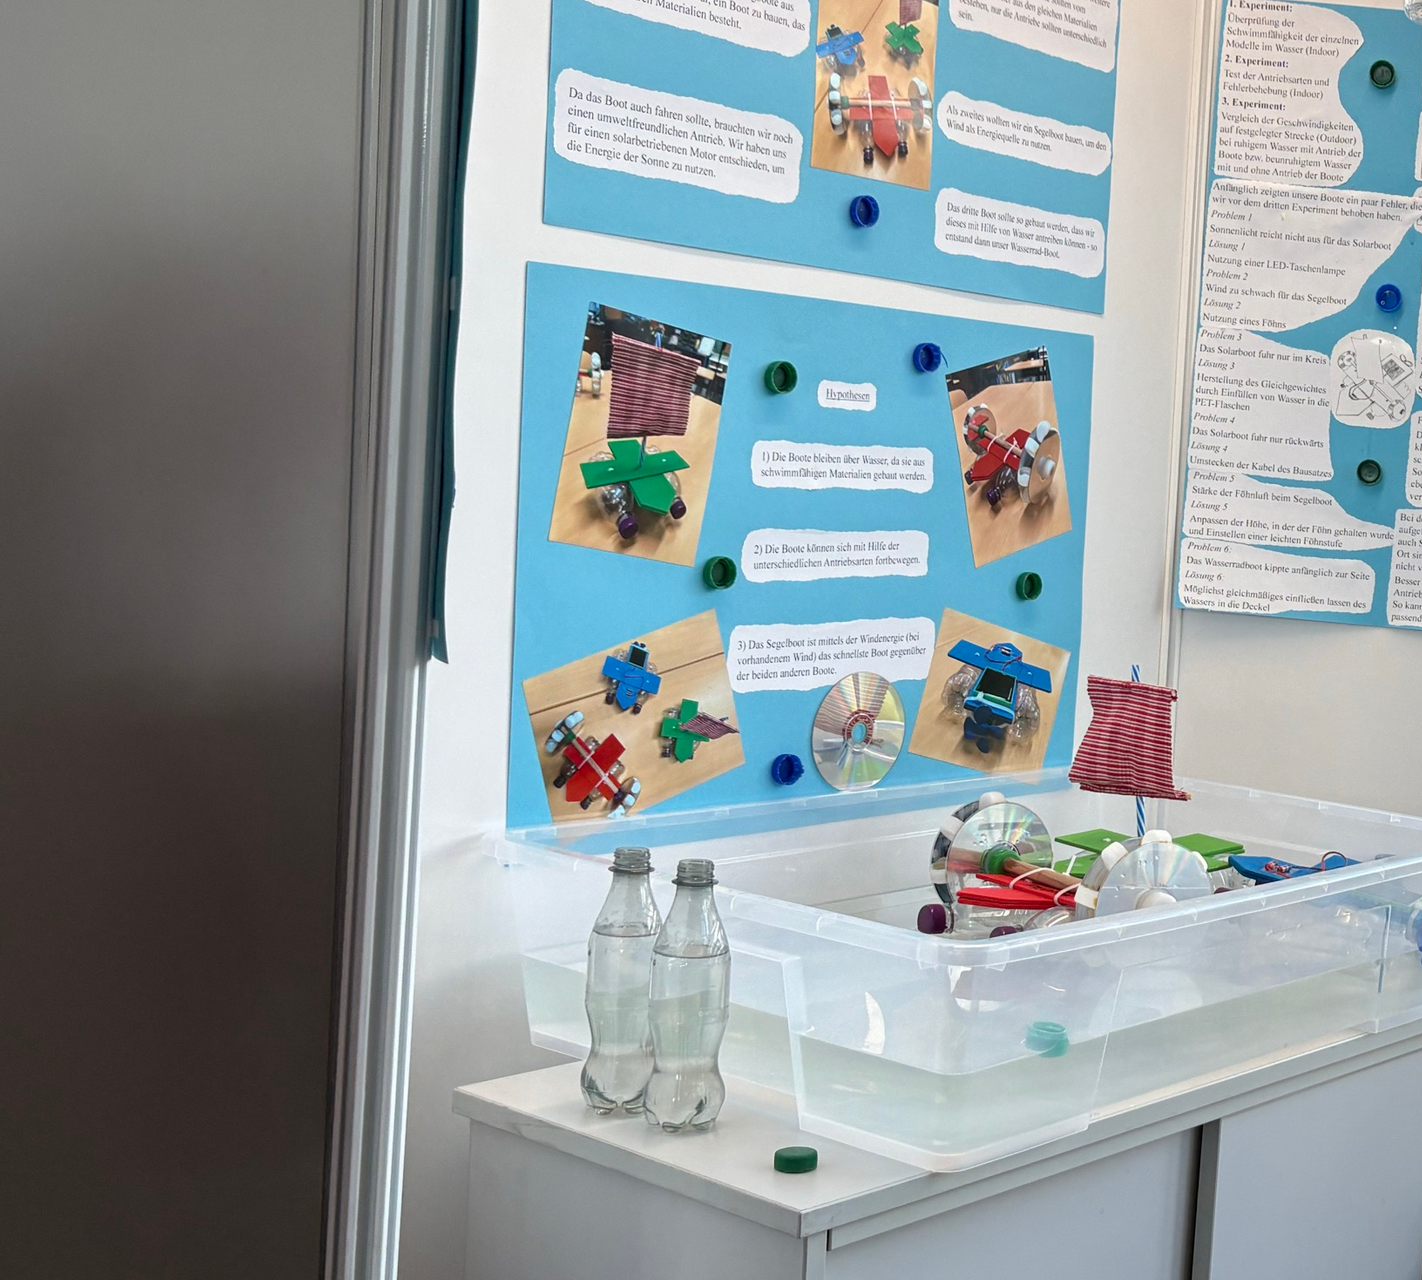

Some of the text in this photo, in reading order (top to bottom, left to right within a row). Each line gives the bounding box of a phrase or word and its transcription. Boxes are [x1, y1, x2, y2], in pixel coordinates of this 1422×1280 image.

[1239, 1, 1292, 12] Experiment:
[709, 11, 742, 29] besteht.
[729, 1, 750, 15] Boot
[752, 8, 762, 18] zu
[764, 10, 790, 28] bauen,
[792, 18, 806, 32] das
[1228, 12, 1295, 28] Überprüfung der
[1227, 27, 1359, 46] Schwimmfähigkeit der einzelnen
[1226, 39, 1340, 58] Modelle im Wasser (Indoor)
[1225, 54, 1289, 68] 2. Experiment:
[1224, 69, 1330, 86] Test der Antriebsarten und
[1223, 82, 1324, 100] Fehlerbehebung (Indoor)
[1222, 97, 1286, 110] 3. Experiment:
[569, 87, 793, 144] Da das Boot auch fahren sollte, brauchten wir noch
[1221, 112, 1354, 131] Vergleich der Geschwindigkeiten
[567, 105, 787, 159] einen umweltfreundlichen Antrieb. Wir haben uns
[946, 105, 959, 116] Als
[960, 110, 985, 122] zweites
[986, 116, 1010, 127] wollten
[1011, 120, 1022, 131] wir
[1023, 123, 1033, 133] ein
[1034, 125, 1064, 140] Segelboot
[1065, 133, 1084, 147] bauen,
[1095, 141, 1107, 151] den
[946, 118, 1052, 151] Wind als Energiequelle zu nutzen.
[567, 122, 785, 174] für einen solarbetriebenen Motor entschieden, um
[567, 140, 716, 177] die Energie der Sonne zu nutzen.
[1211, 210, 1253, 222] Problem 1
[945, 233, 1060, 258] entstand dann unser Wasserrad-Boot.
[1208, 239, 1246, 252] Lösung 1
[1208, 254, 1346, 277] Nutzung einer LED-Taschenlampe
[826, 389, 870, 402] Hypothesen
[762, 451, 770, 464] 1)
[772, 451, 787, 462] Die
[788, 452, 812, 463] Boote
[813, 453, 842, 463] bleiben
[843, 454, 860, 464] über
[862, 455, 889, 466] Wasser,
[890, 456, 900, 466] da
[901, 456, 912, 466] sie
[761, 467, 927, 482] schwimmfähigen Materialien gebaut werden.
[754, 541, 900, 556] 2) Die Boote können sich mit Hilfe der
[753, 555, 921, 569] unterschiedlichen Antriebsarten fortbewegen.
[1186, 556, 1202, 565] Das
[1204, 558, 1263, 570] Wasserradboot
[1264, 563, 1290, 574] kippte
[1291, 567, 1333, 578] anfänglich
[1350, 571, 1370, 580] Seite
[737, 632, 920, 652] 3) Das Segelboot ist mittels der Windenergie (bei
[737, 646, 927, 665] vorhandenem Wind) das schnellste Boot gegenüber
[736, 666, 837, 681] der beiden anderen Boote.
